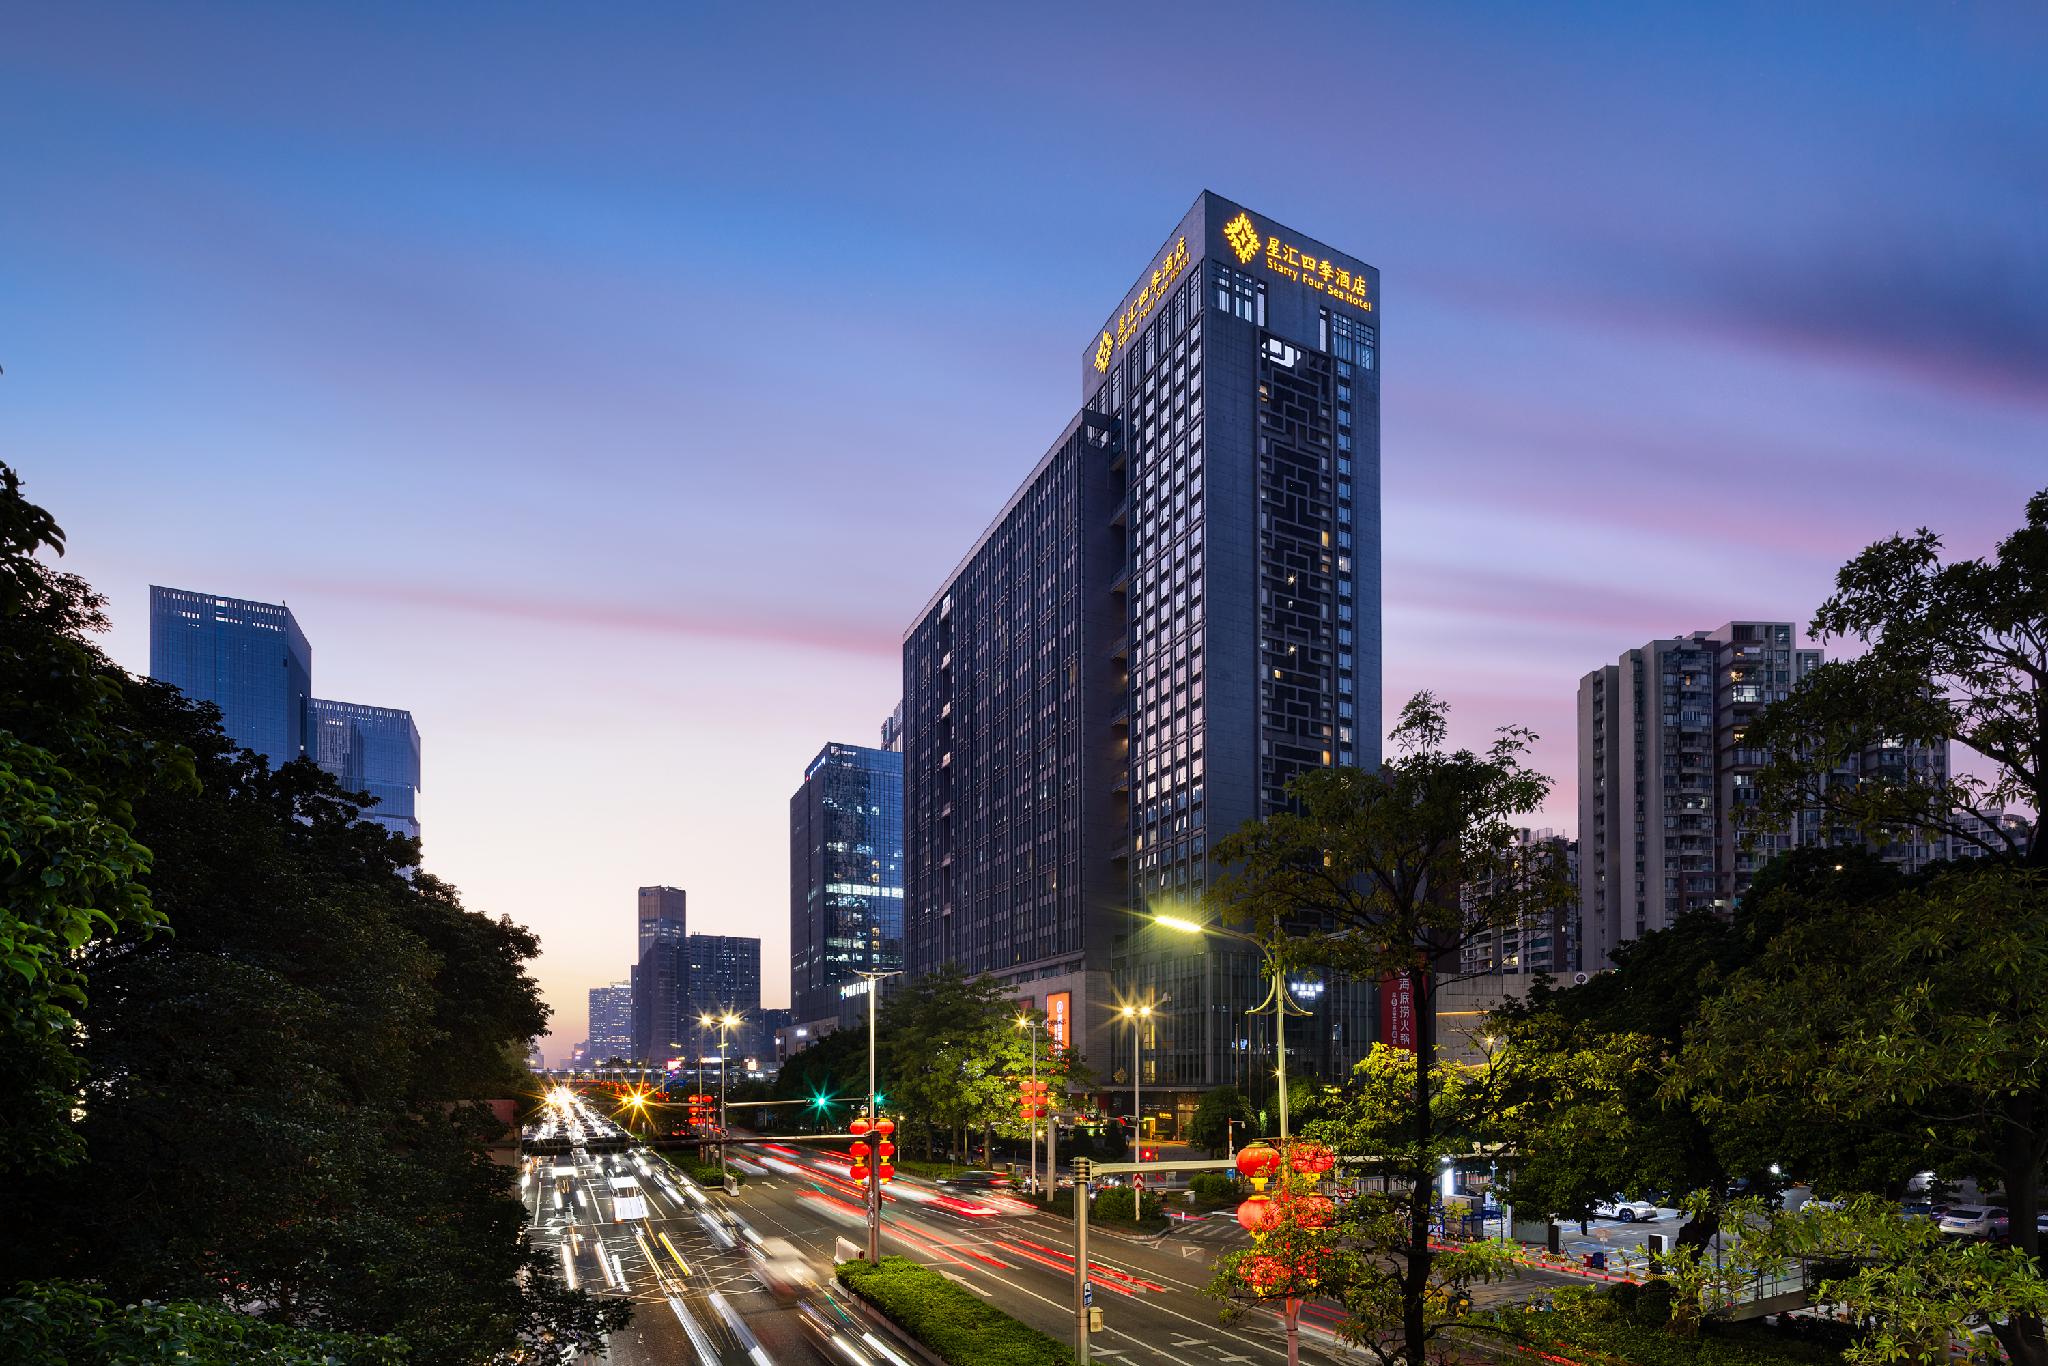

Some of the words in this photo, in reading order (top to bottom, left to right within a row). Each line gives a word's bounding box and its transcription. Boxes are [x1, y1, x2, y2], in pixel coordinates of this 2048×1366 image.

[1266, 237, 1366, 297] 星汇四季酒店
[1267, 257, 1299, 281] Starry
[1302, 273, 1324, 291] Four
[1327, 284, 1344, 300] Sea
[1346, 292, 1372, 312] Hotel
[1399, 978, 1410, 1045] 海底捞火锅
